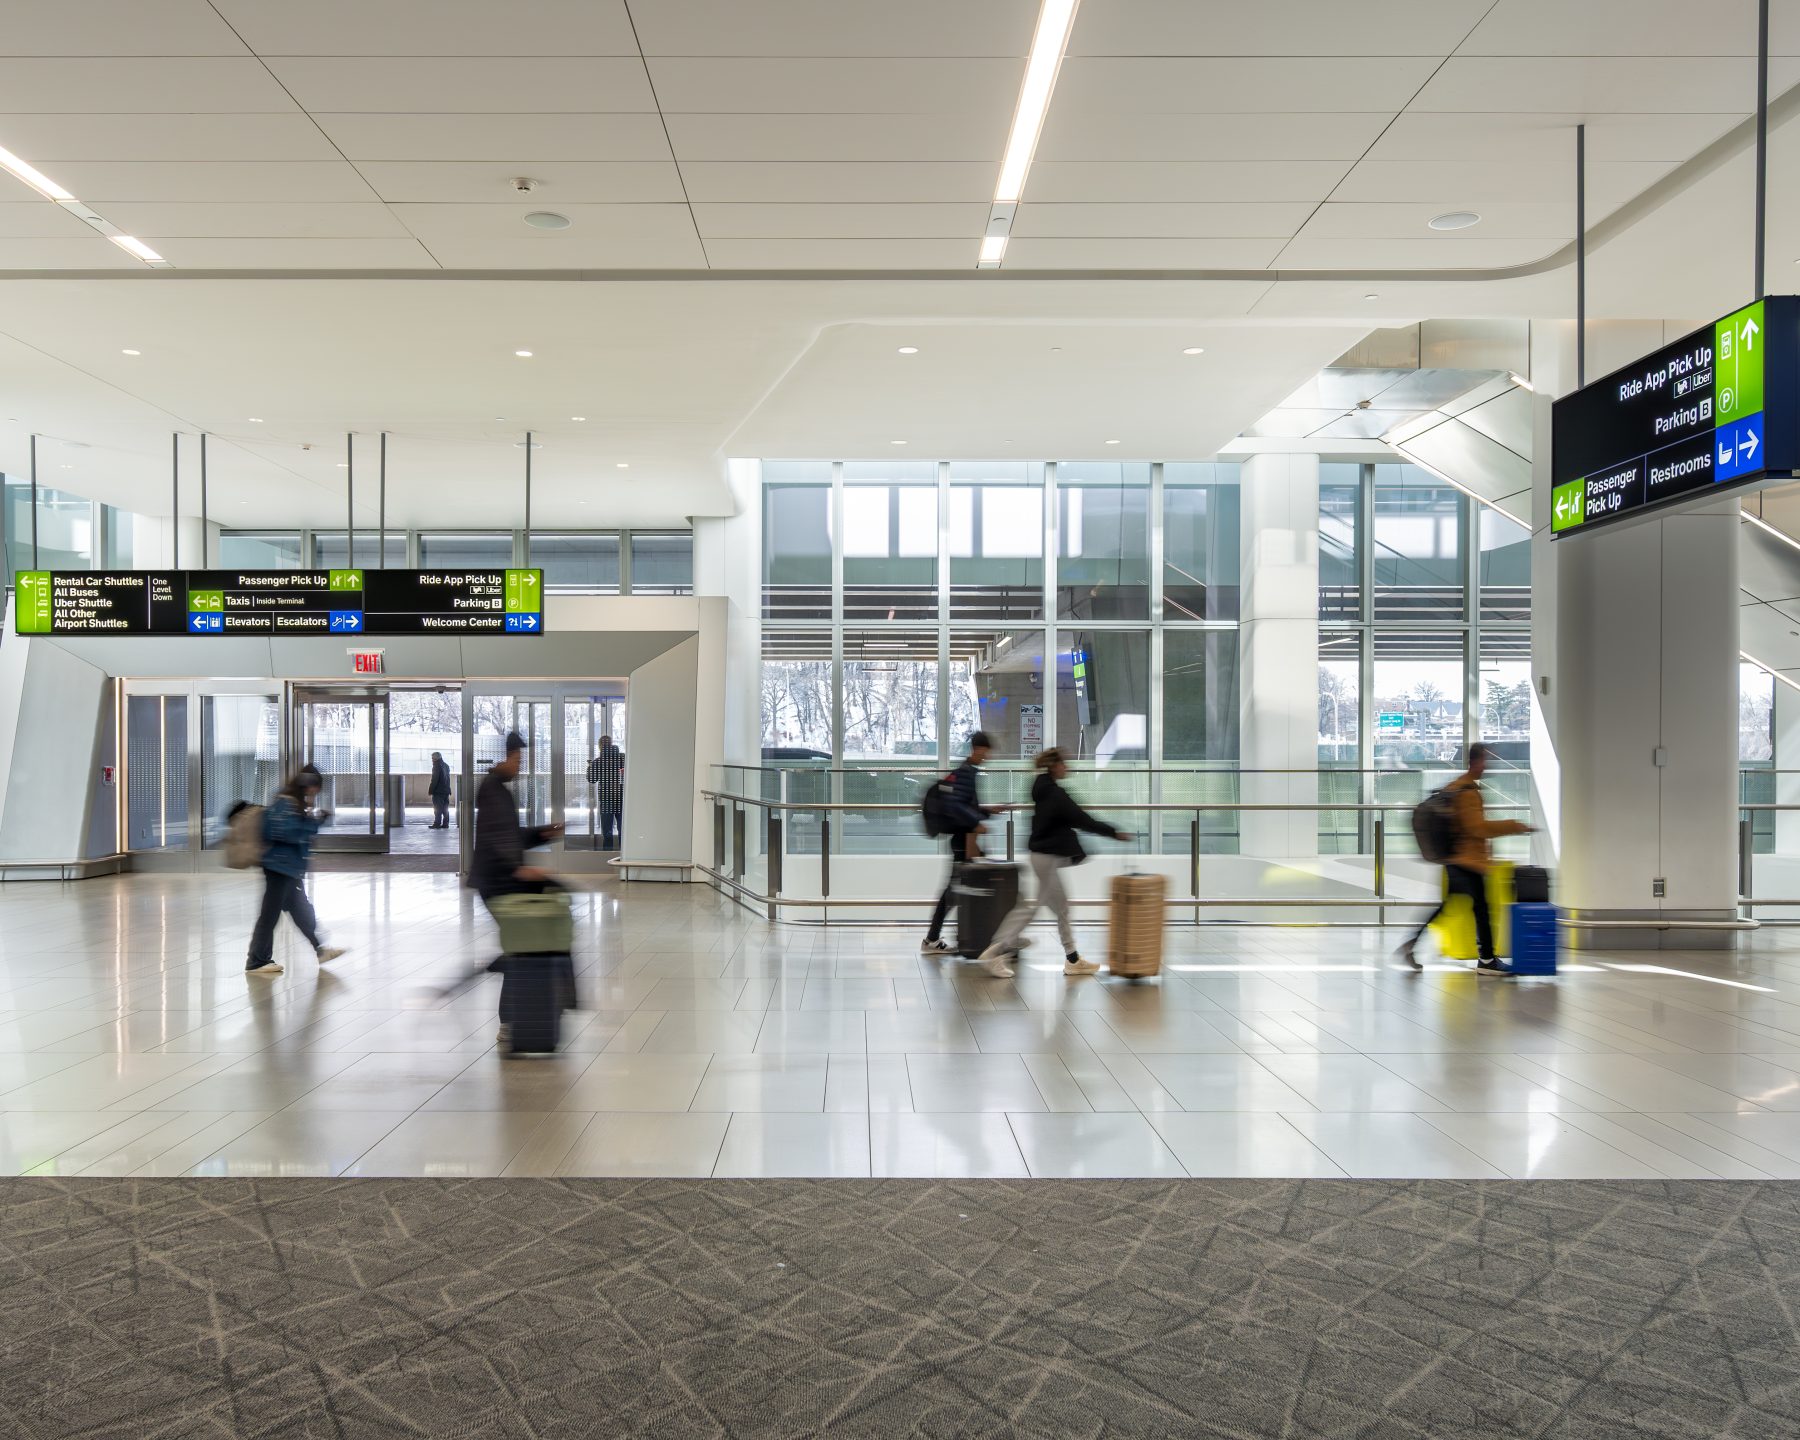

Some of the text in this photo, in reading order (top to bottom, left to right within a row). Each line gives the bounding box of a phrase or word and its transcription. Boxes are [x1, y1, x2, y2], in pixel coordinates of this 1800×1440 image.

[1620, 347, 1712, 401] Ride App Pick Up
[1693, 373, 1711, 387] Uber
[1655, 406, 1697, 435] Parking
[1650, 453, 1711, 485] Restrooms
[1587, 468, 1637, 497] Passenger
[1586, 492, 1621, 516] Pick Up
[54, 577, 144, 586] Rental Car Shuttles
[239, 576, 327, 587] Passenger Pick Up
[419, 575, 502, 587] Ride App Pick Up
[54, 588, 99, 597] All Buses
[54, 599, 113, 608] Uber Shuttle
[225, 596, 250, 606] Taxis
[256, 597, 305, 605] Inside Terminal
[453, 599, 490, 610] Parking
[54, 609, 97, 618] All Other
[54, 619, 128, 629] Airport Shuttles
[225, 617, 271, 627] Elevators
[277, 617, 328, 627] Escalators
[422, 618, 502, 628] Welcome Center
[355, 654, 378, 672] EXIT
